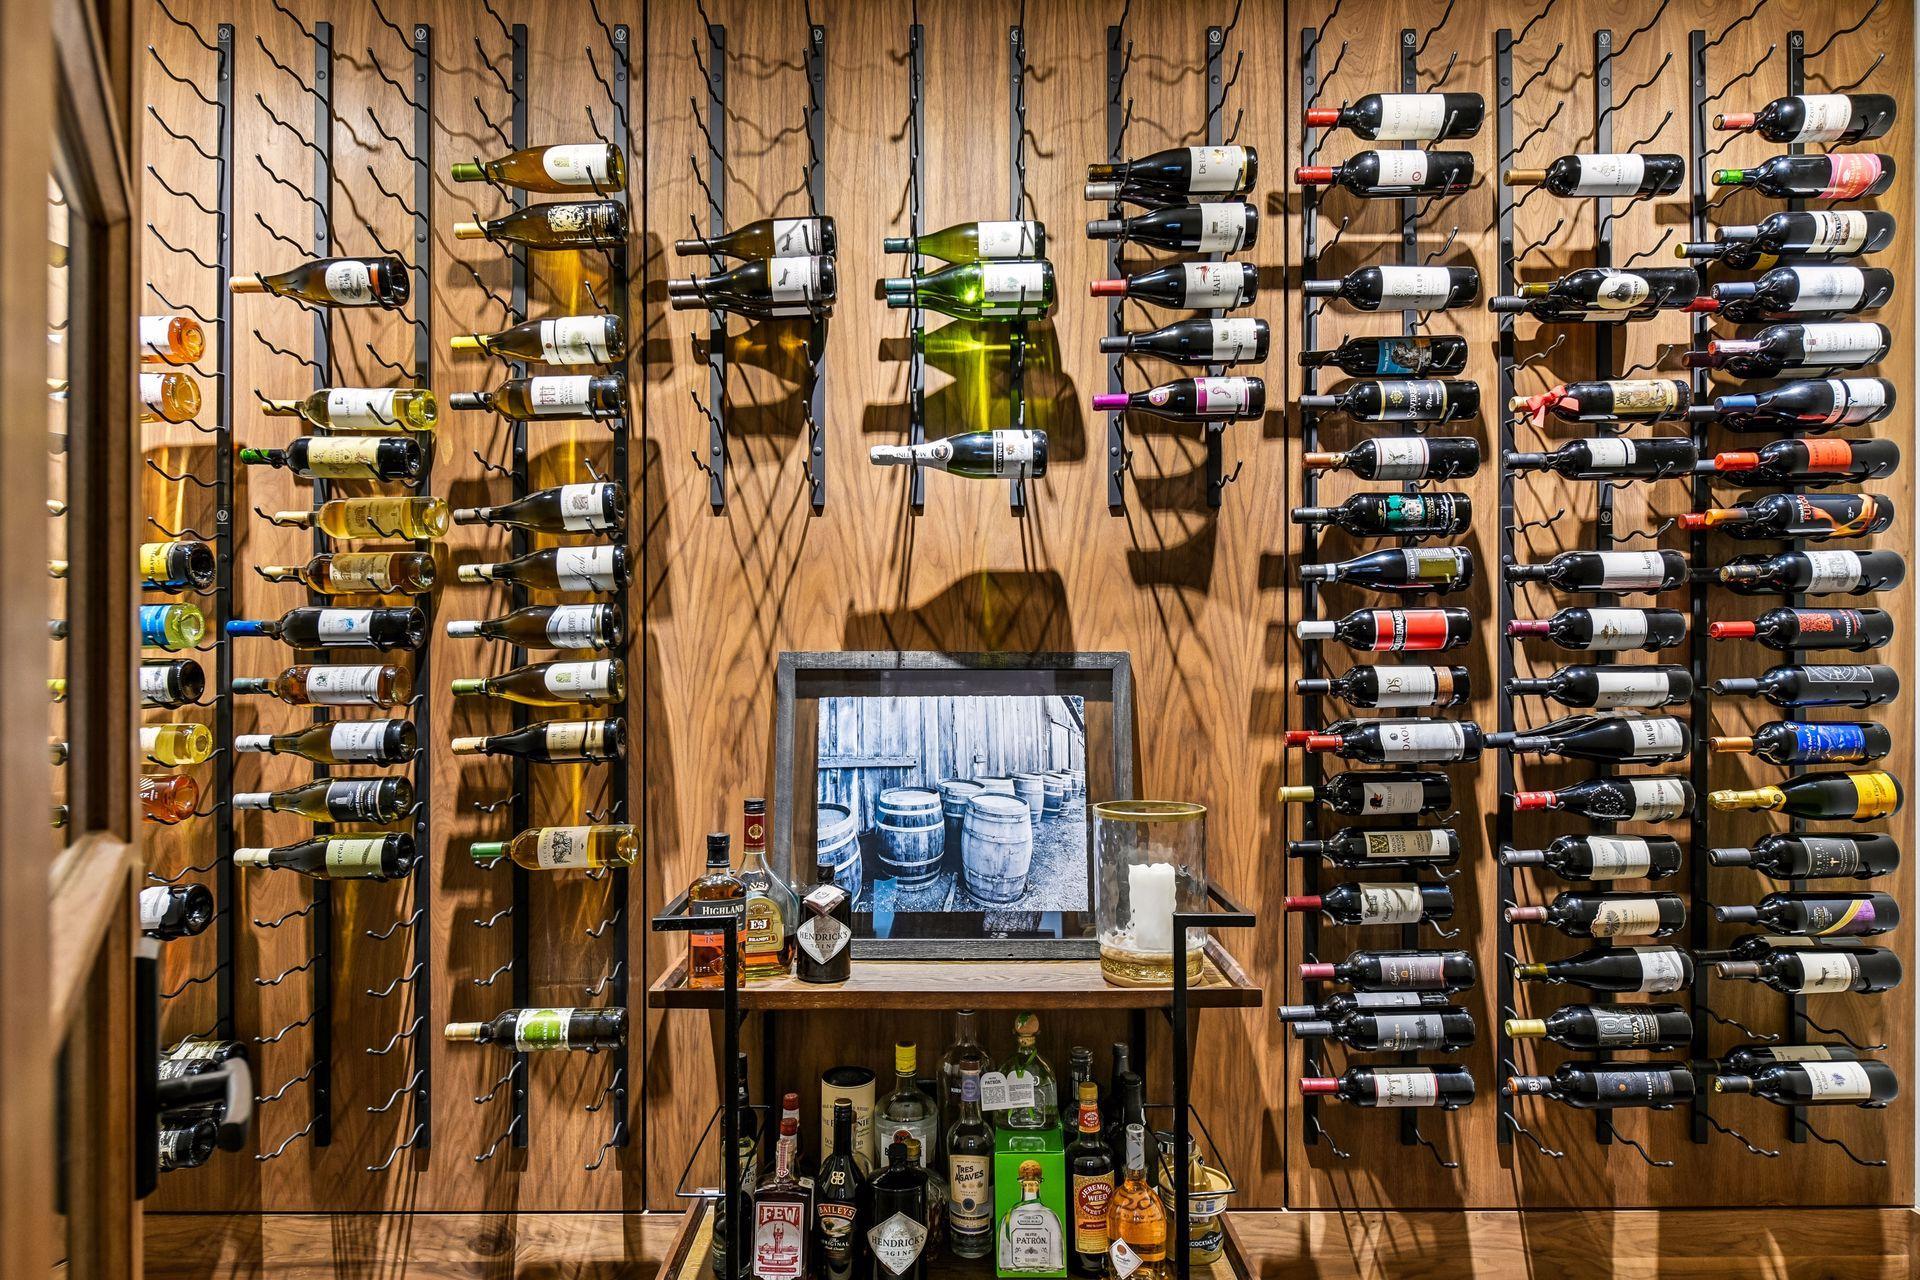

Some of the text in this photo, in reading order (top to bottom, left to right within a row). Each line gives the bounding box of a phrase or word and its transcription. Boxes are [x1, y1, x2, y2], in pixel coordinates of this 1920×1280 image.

[1212, 267, 1221, 297] HAHN
[1404, 381, 1418, 419] SOVEREIGN
[1831, 386, 1840, 418] LIMITED
[896, 450, 927, 459] MATINI
[1797, 495, 1812, 520] FUEGO
[1406, 549, 1416, 580] GIRIBALD
[1843, 616, 1852, 640] APOTHIC
[1646, 732, 1657, 746] SAN
[1814, 846, 1823, 876] TITUS
[702, 905, 745, 916] HIGHLAND
[749, 918, 767, 930] E&J
[799, 930, 848, 941] HENDRICK'S
[1632, 1021, 1641, 1045] NAPA
[954, 1169, 984, 1184] AGAVES
[957, 1164, 974, 1180] TRES
[1082, 1182, 1112, 1198] JEREMIAH
[1087, 1193, 1108, 1202] WEED
[762, 1206, 797, 1222] FEW
[819, 1204, 855, 1218] BAILEYS
[871, 1233, 925, 1248] HENDRICK'S
[1016, 1236, 1048, 1245] PATRÓN
